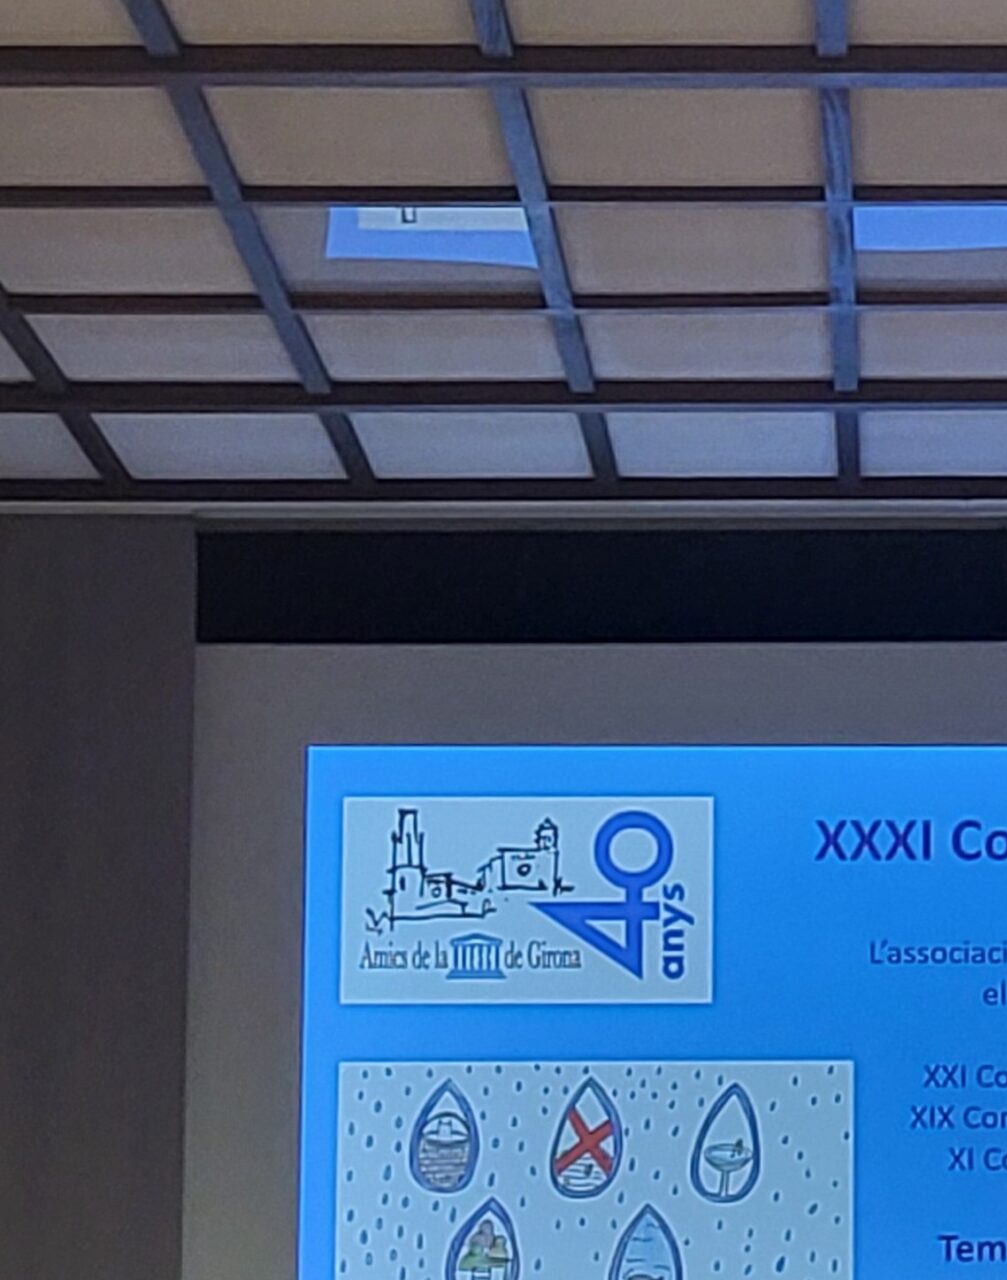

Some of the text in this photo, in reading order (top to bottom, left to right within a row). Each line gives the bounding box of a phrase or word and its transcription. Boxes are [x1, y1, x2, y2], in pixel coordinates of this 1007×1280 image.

[814, 819, 932, 862] XXXI
[661, 882, 695, 980] anys
[360, 938, 450, 970] Amics de la
[504, 938, 583, 970] de Girona
[982, 979, 1007, 1006] el
[923, 1063, 967, 1089] XXI
[910, 1104, 955, 1130] XIX
[947, 1146, 974, 1172] XI
